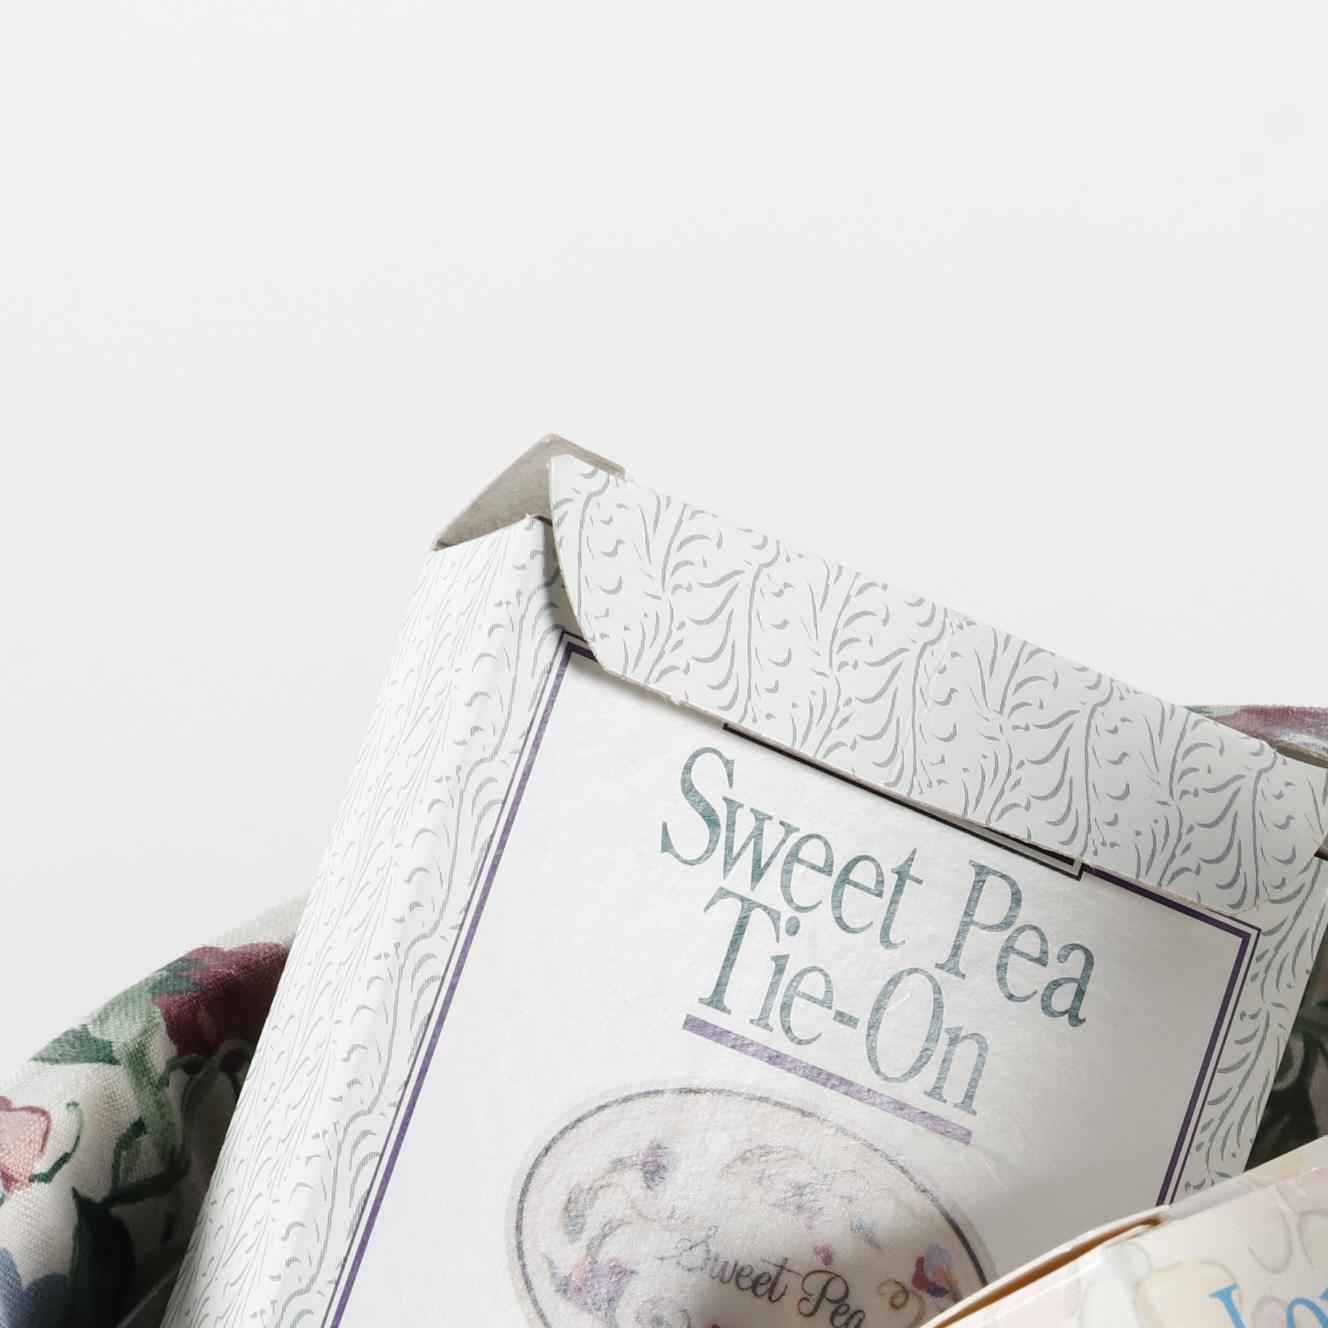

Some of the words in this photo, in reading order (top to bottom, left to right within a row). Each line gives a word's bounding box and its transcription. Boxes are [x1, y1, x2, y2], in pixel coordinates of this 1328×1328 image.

[661, 746, 923, 951] Sweet
[935, 860, 1099, 1028] Pea
[698, 887, 989, 1117] Tie-On
[656, 1225, 802, 1303] Sweet
